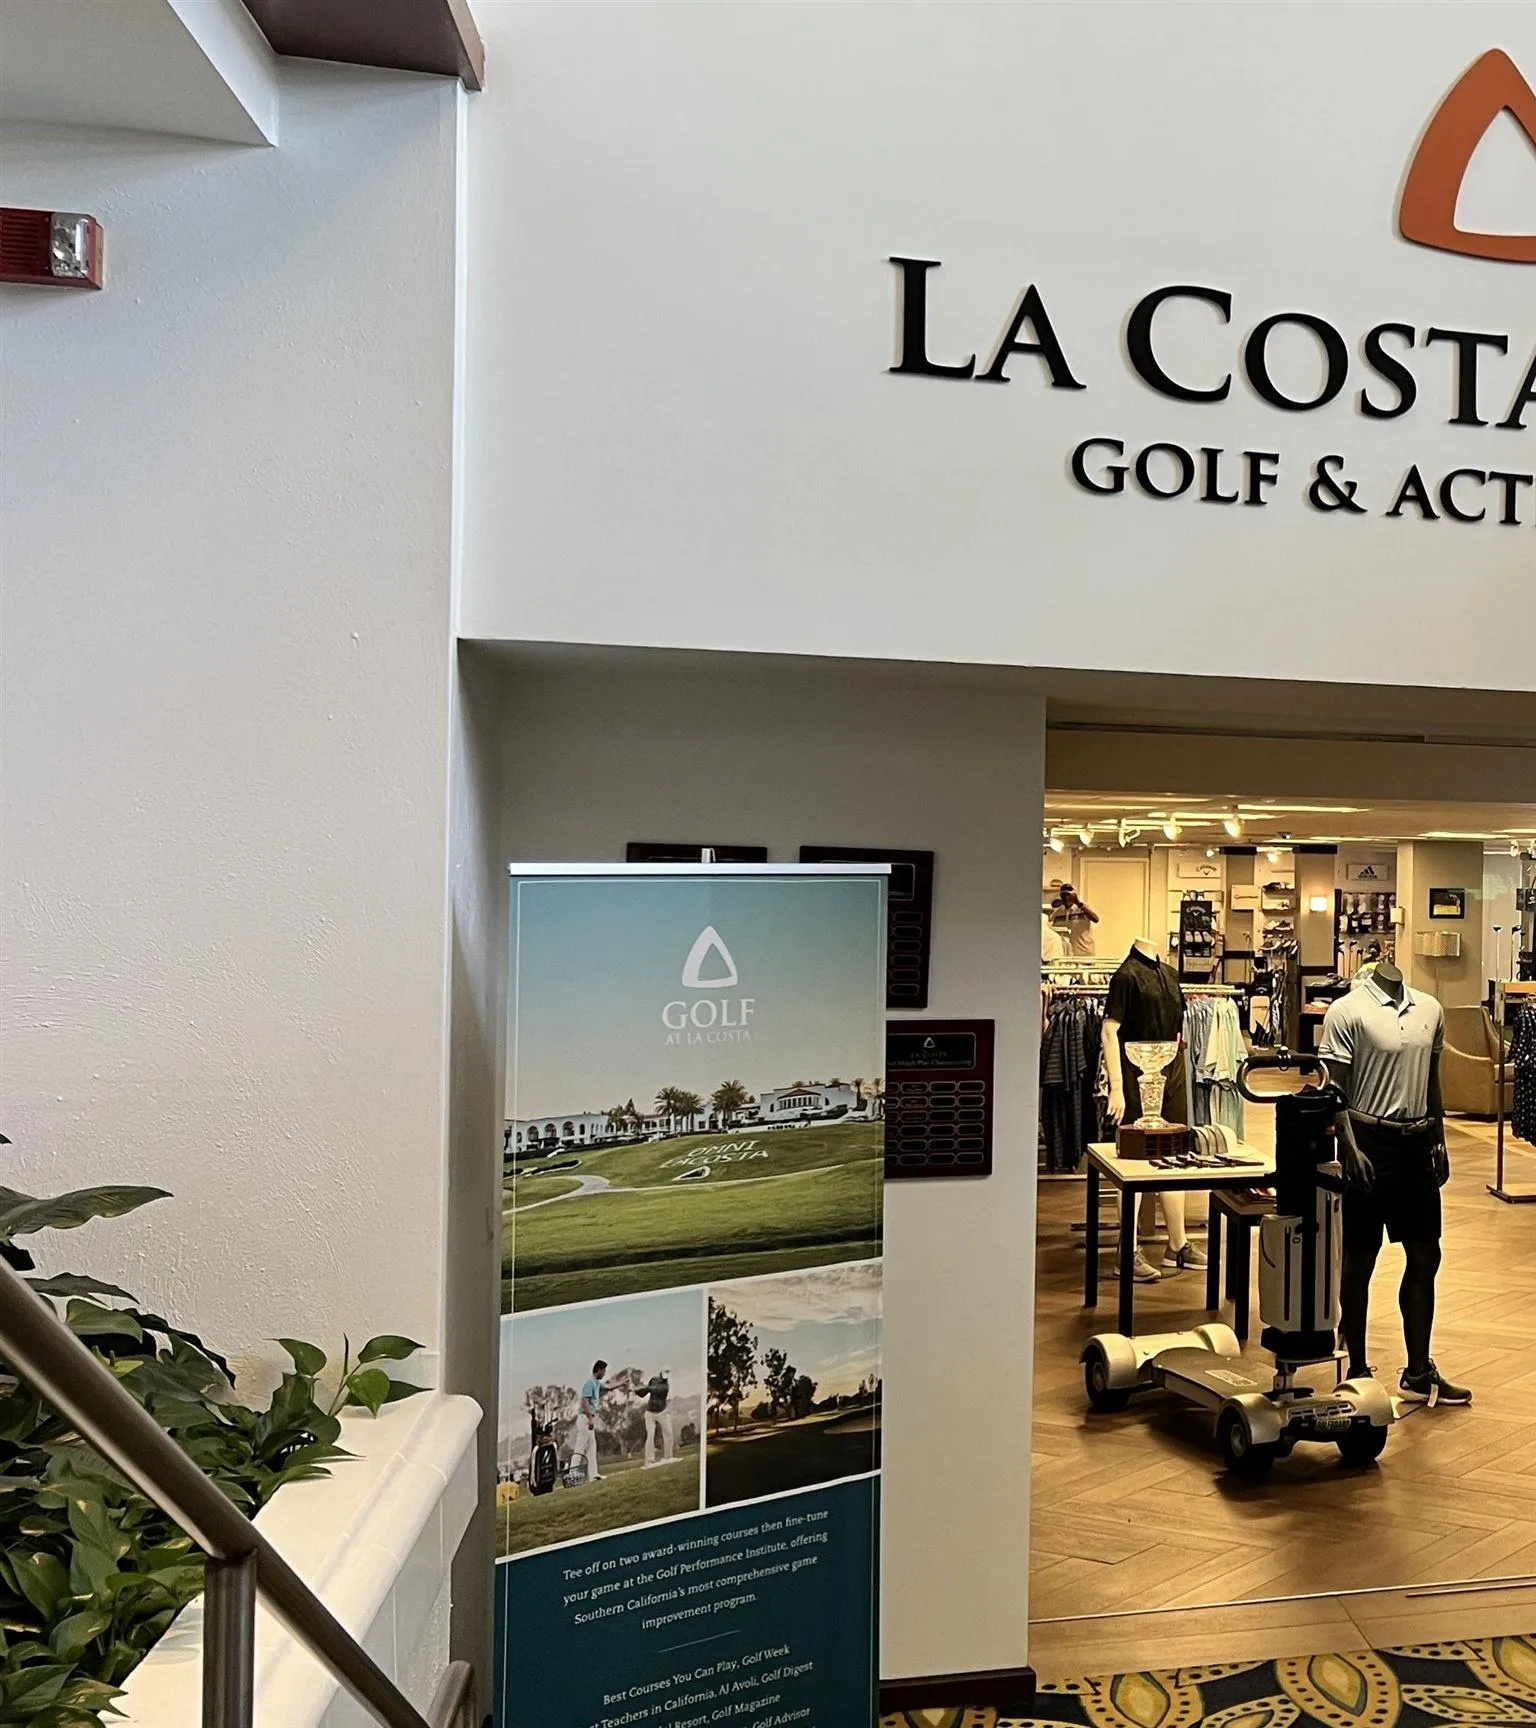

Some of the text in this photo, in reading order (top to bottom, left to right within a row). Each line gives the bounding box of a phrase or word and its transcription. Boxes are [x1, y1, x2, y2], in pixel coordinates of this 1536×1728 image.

[888, 256, 1087, 390] LA
[1071, 437, 1280, 505] GOLF
[1308, 455, 1367, 514] &
[661, 998, 755, 1030] GOLF
[687, 1031, 704, 1046] LA
[707, 1029, 751, 1044] COSTA
[687, 1140, 760, 1157] OMNI
[563, 1510, 829, 1580] Tee off on two award-winning courses then fine-tune
[563, 1589, 589, 1607] your
[591, 1581, 621, 1600] game
[623, 1578, 634, 1589] at
[637, 1573, 654, 1585] the
[656, 1562, 679, 1580] Golf
[680, 1551, 744, 1573] Performance
[790, 1531, 829, 1548] offering
[574, 1603, 625, 1625] Southern
[688, 1580, 714, 1595] most
[715, 1561, 790, 1588] comprehensive
[791, 1555, 819, 1572] game
[642, 1603, 712, 1629] improvement
[600, 1708, 649, 1728] Teachers
[651, 1704, 662, 1715] in
[718, 1682, 730, 1695] AJ
[761, 1667, 782, 1683] Golf
[783, 1661, 813, 1678] Digest
[603, 1691, 627, 1706] Best
[628, 1678, 671, 1698] Courses
[673, 1673, 692, 1685] You
[694, 1666, 714, 1679] Can
[716, 1660, 740, 1672] Play,
[674, 1714, 710, 1728] Resort,
[711, 1705, 733, 1720] Golf
[734, 1693, 781, 1714] Magazine
[752, 1706, 812, 1728] Golf Advisor
